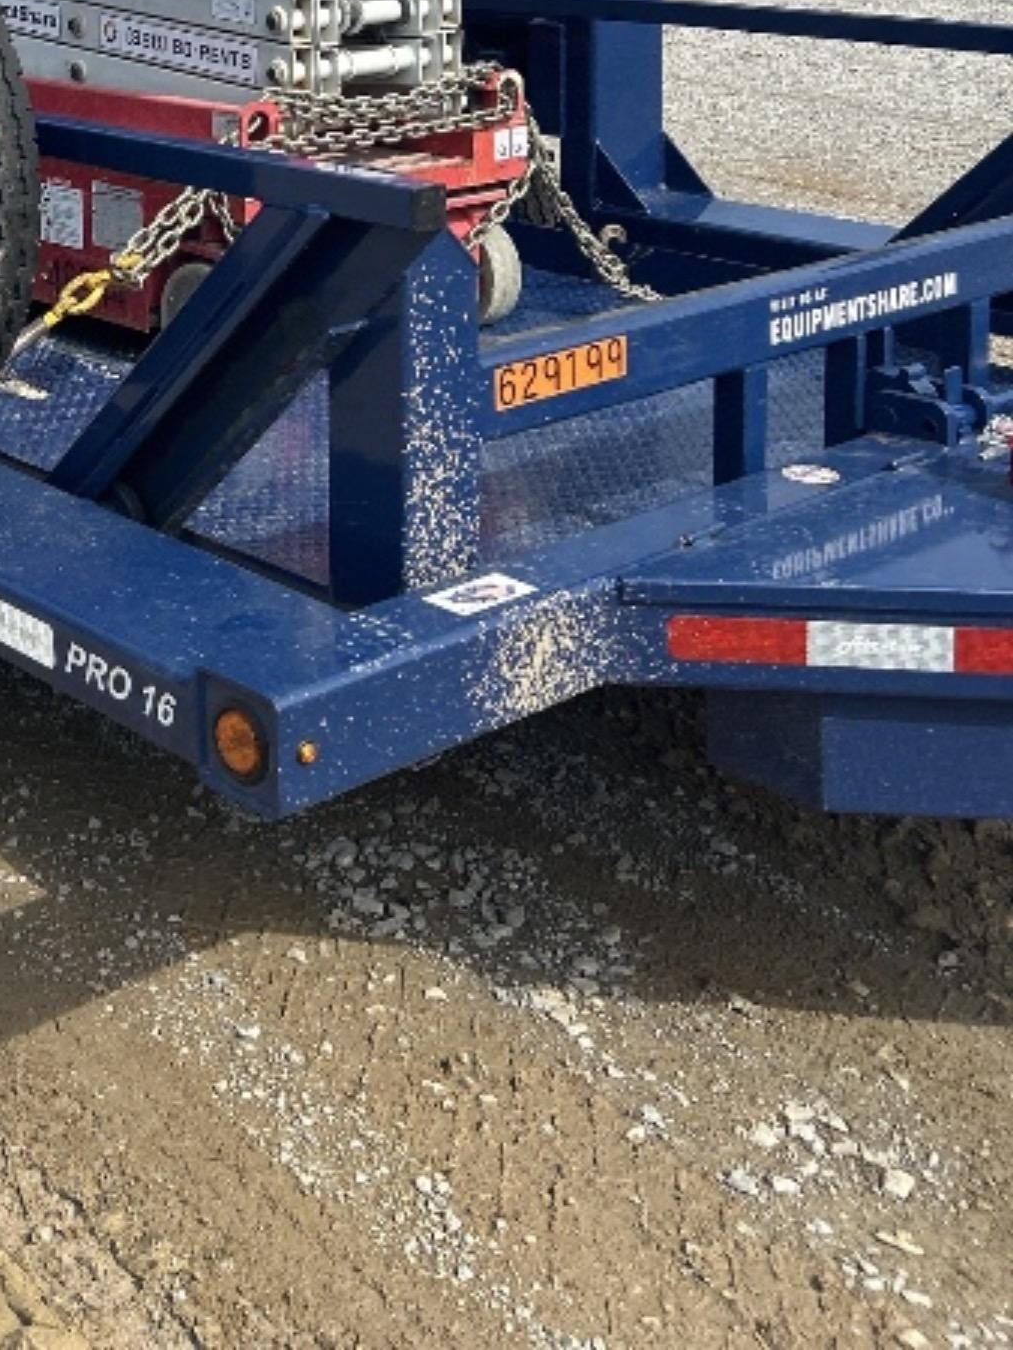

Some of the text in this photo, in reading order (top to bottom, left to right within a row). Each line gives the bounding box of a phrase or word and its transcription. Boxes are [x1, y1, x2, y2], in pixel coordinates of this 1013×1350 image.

[769, 272, 958, 346] EQUIPMENTSHARE.COM
[498, 338, 624, 406] 629199
[64, 641, 178, 727] PRO 16
